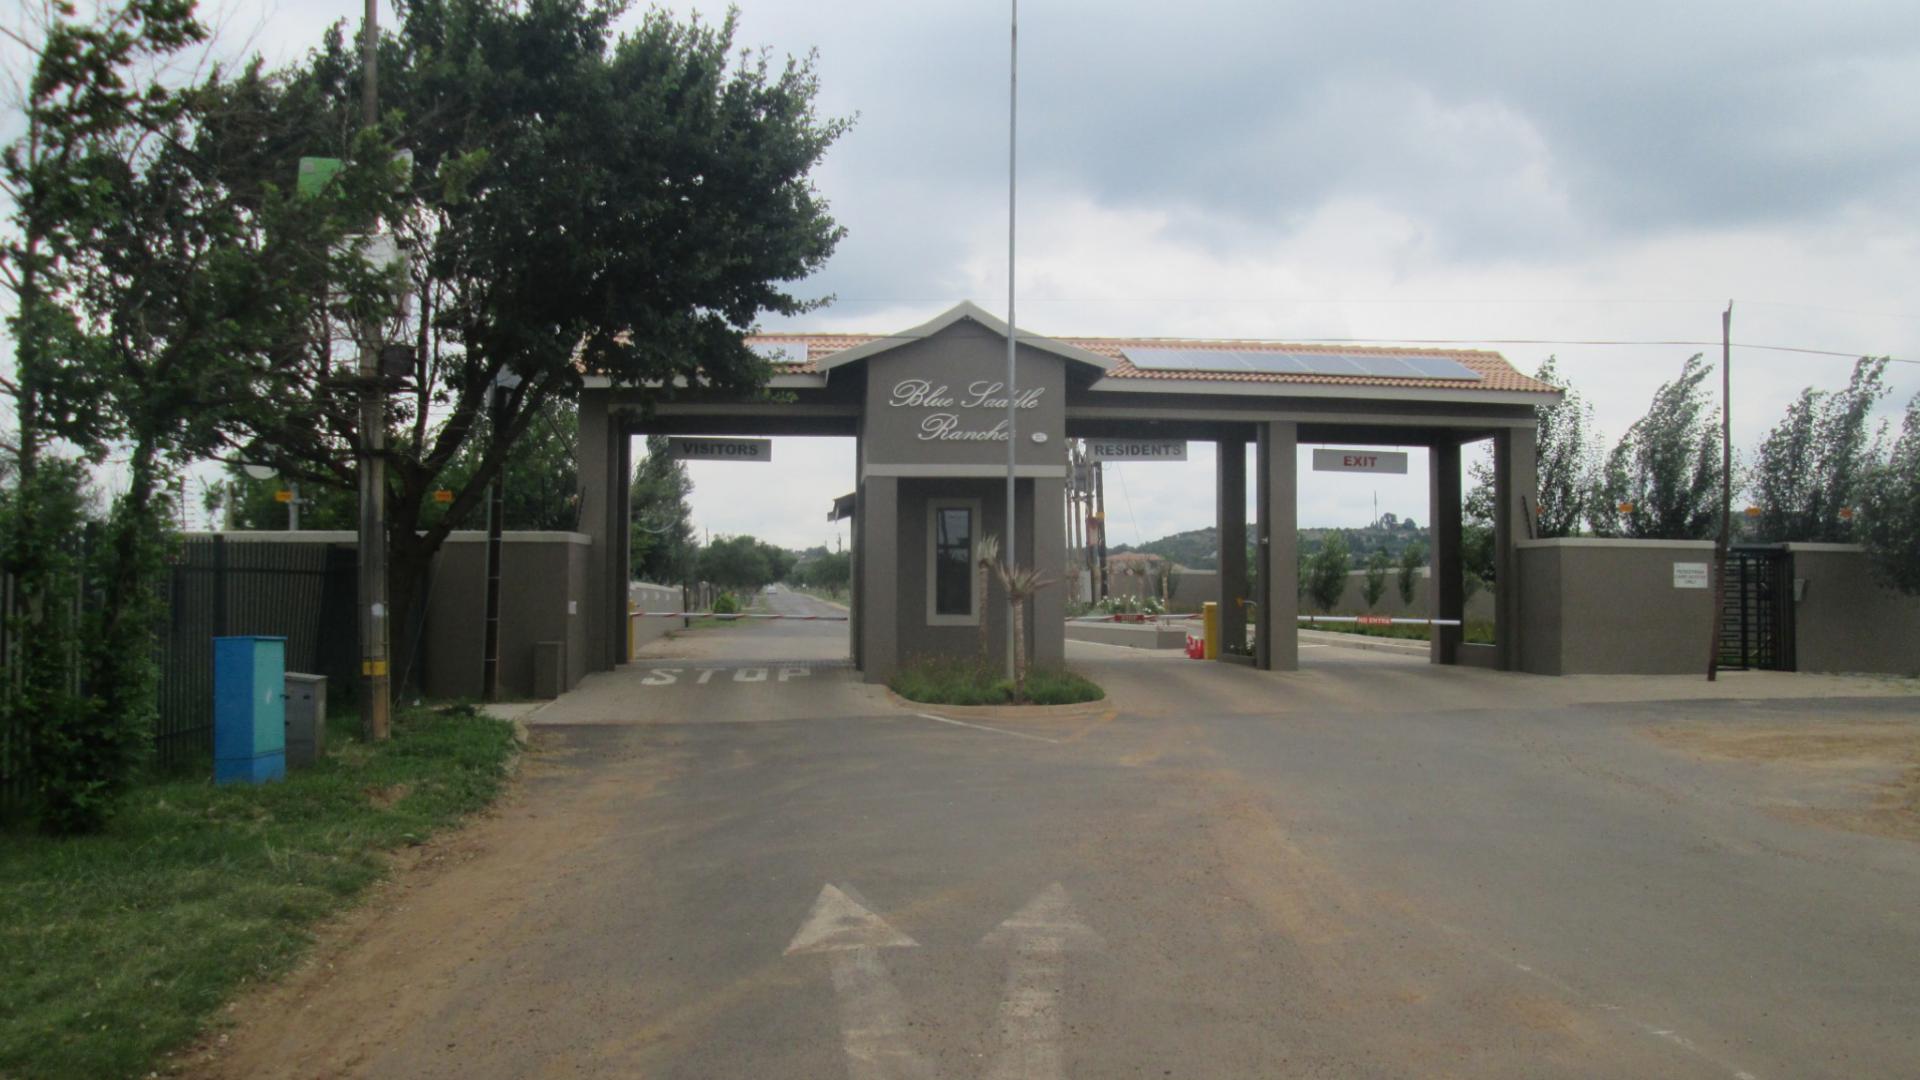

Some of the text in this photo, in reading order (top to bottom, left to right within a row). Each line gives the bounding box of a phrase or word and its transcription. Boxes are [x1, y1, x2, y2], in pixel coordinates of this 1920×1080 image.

[889, 379, 954, 407] Blue
[682, 443, 759, 456] VISITORS
[1094, 444, 1182, 456] RESIDENTS
[1343, 455, 1377, 468] EXIT
[641, 667, 812, 686] STOP
